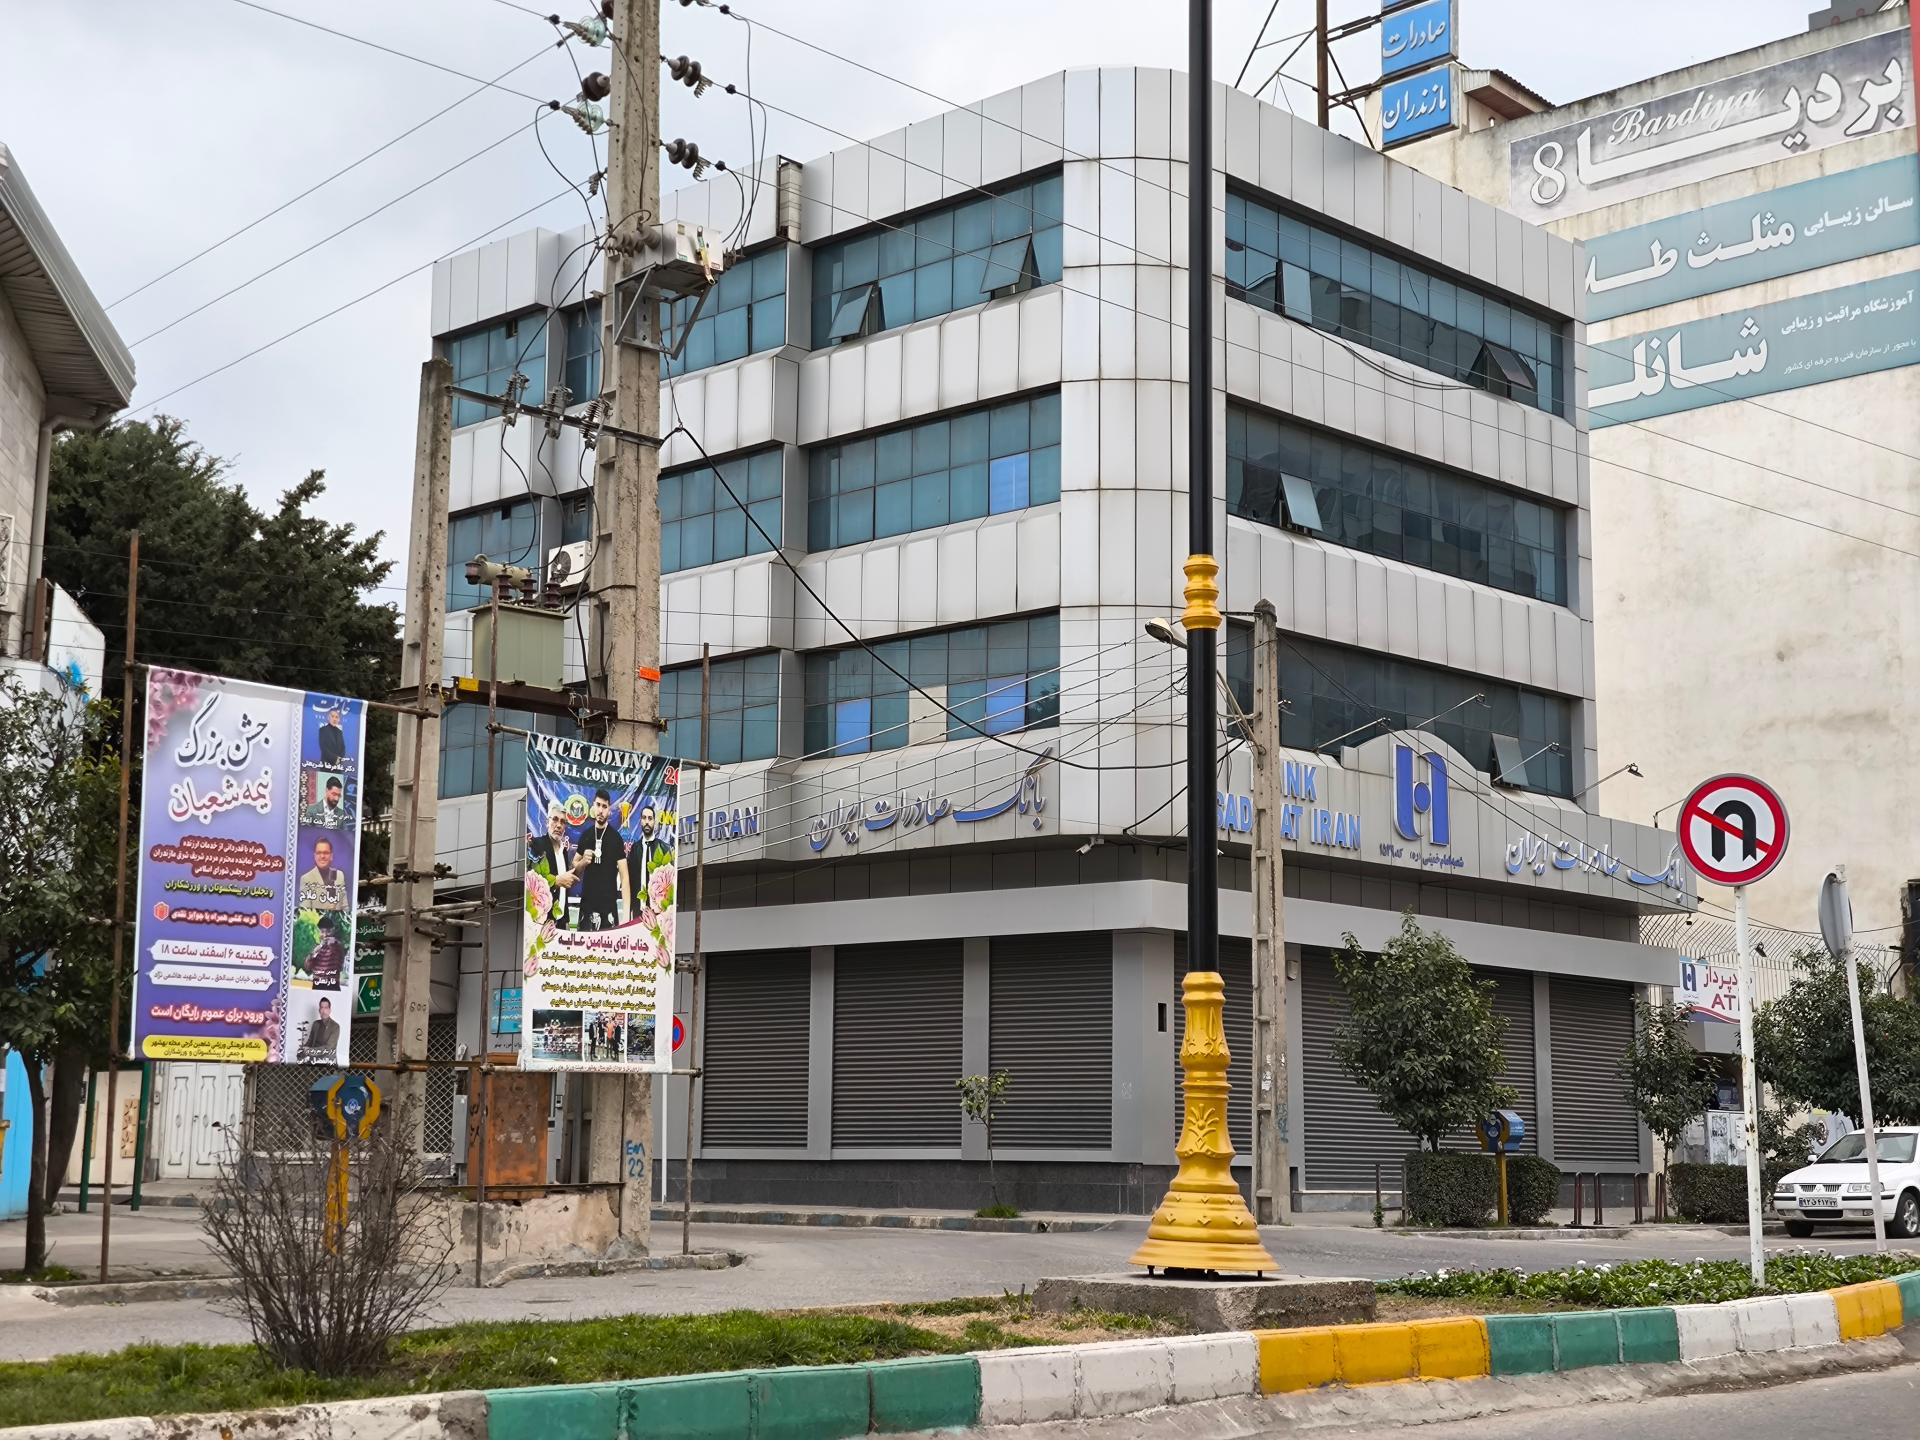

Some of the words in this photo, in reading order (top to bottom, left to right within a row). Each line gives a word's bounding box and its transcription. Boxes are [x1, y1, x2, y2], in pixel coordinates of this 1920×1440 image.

[1382, 19, 1446, 58] صادرات
[1382, 84, 1447, 130] مازندران
[1608, 86, 1766, 146] Bardiya
[1576, 57, 1904, 188] بردیا
[1530, 141, 1566, 205] 8
[1804, 206, 1861, 237] زیبایی
[1865, 196, 1914, 222] سالن
[1687, 210, 1796, 269] مثلث
[1825, 306, 1862, 322] مراقبت
[1863, 289, 1914, 314] آموزشگاه
[1781, 315, 1814, 335] زیبایی
[1817, 316, 1823, 328] و
[178, 693, 225, 766] بزرگ
[227, 713, 268, 767] جشن
[536, 734, 583, 760] KICK
[588, 746, 653, 771] BOXING
[545, 759, 580, 778] FULL
[583, 766, 641, 787] CONTACT
[171, 778, 240, 821] شعبان
[242, 769, 270, 810] نیمه
[953, 746, 1053, 831] بانک
[865, 788, 952, 832] صادرات
[708, 806, 760, 841] IRAN
[809, 797, 865, 853] ایران
[1310, 807, 1361, 850] IRAN
[153, 848, 176, 859] مازندران
[1505, 831, 1549, 875] ایران
[1552, 840, 1622, 878] صادرات
[299, 889, 317, 903] فلاح
[319, 890, 340, 904] ایمان
[161, 943, 170, 954] ۱۸
[171, 944, 198, 957] ساعت
[199, 945, 228, 959] اسفند
[228, 948, 233, 959] ۶
[558, 933, 586, 950] عالیه
[586, 934, 613, 953] بنیامین
[613, 935, 629, 953] آقای
[631, 937, 650, 956] جناب
[235, 949, 268, 966] یکشنبه
[151, 1004, 173, 1018] است
[173, 1004, 199, 1020] رایگان
[200, 1008, 225, 1022] عموم
[225, 1007, 243, 1022] برای
[243, 1009, 264, 1023] ورود
